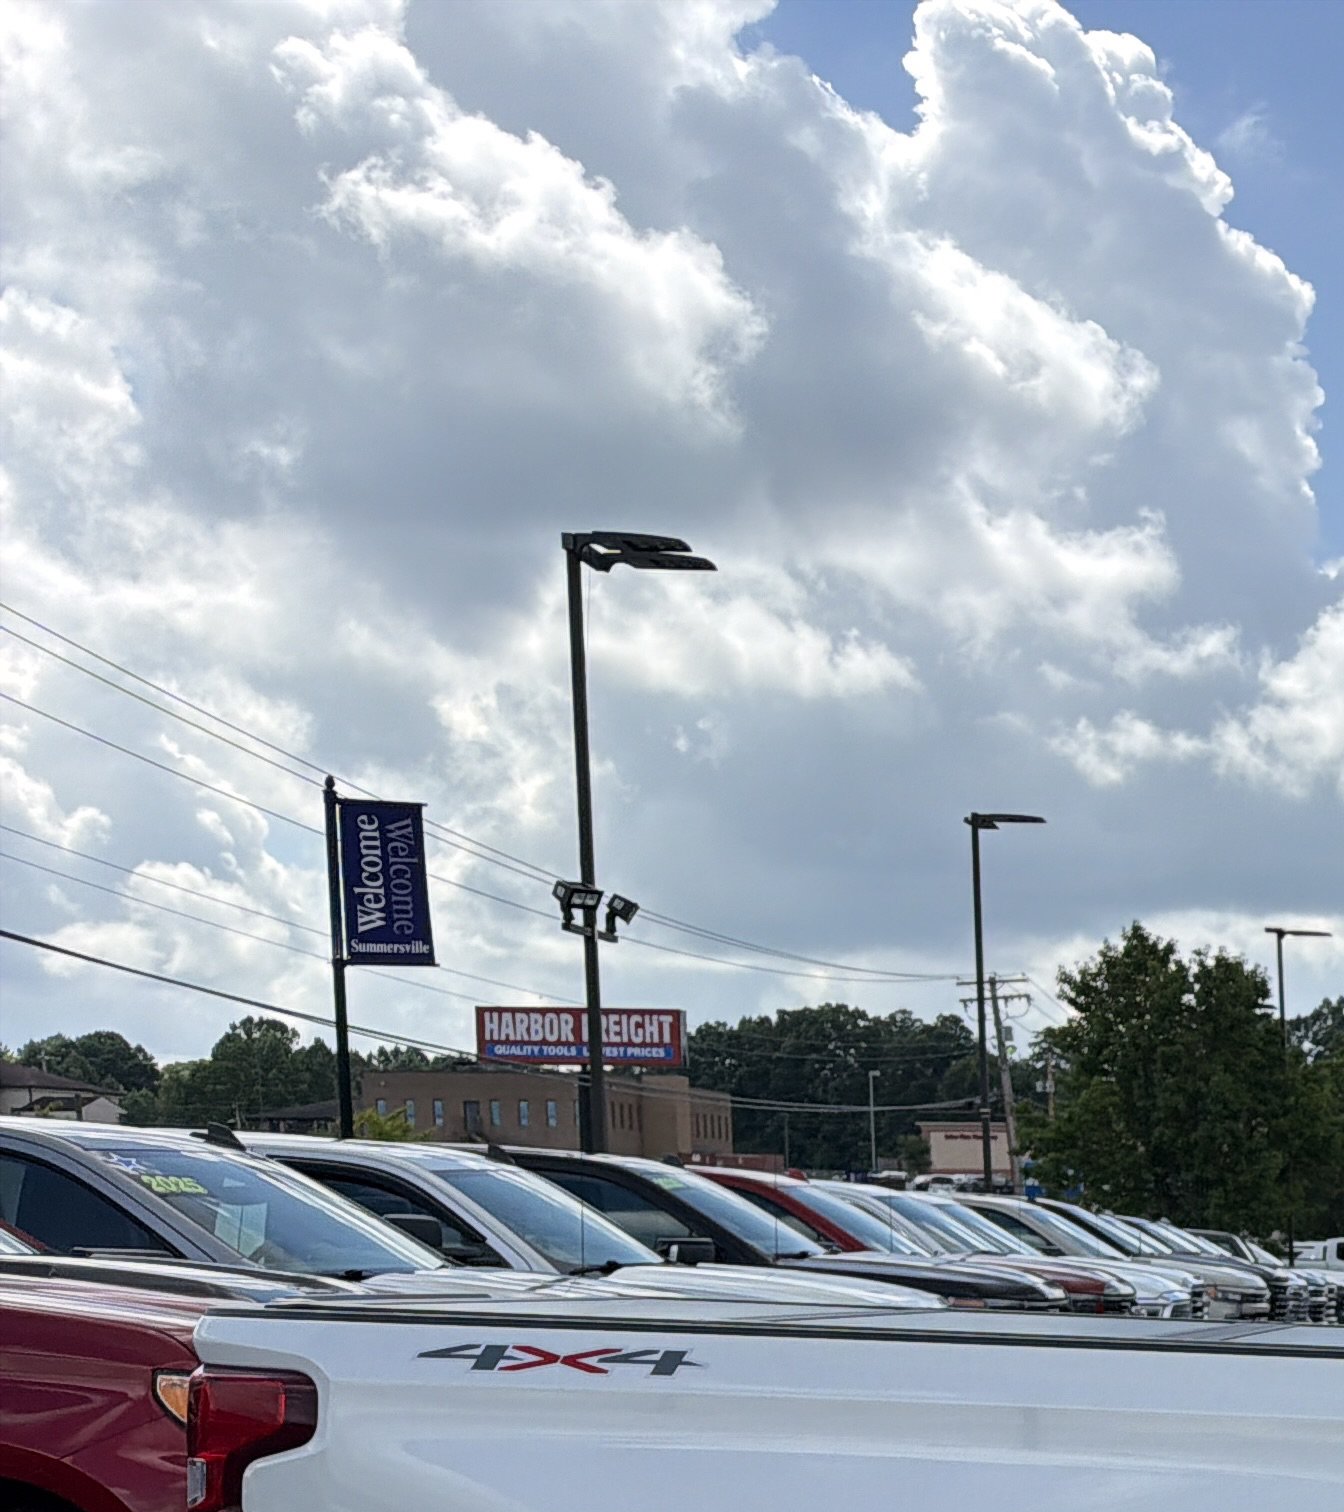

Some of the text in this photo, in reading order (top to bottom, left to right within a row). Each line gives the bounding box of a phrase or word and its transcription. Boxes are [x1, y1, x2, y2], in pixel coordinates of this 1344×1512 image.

[353, 814, 386, 934] Welcome
[385, 818, 419, 935] Welcome
[350, 939, 430, 954] Summersville
[484, 1011, 575, 1042] HARBOR
[494, 1044, 665, 1058] QUALITY TOOLS LEST PRICES
